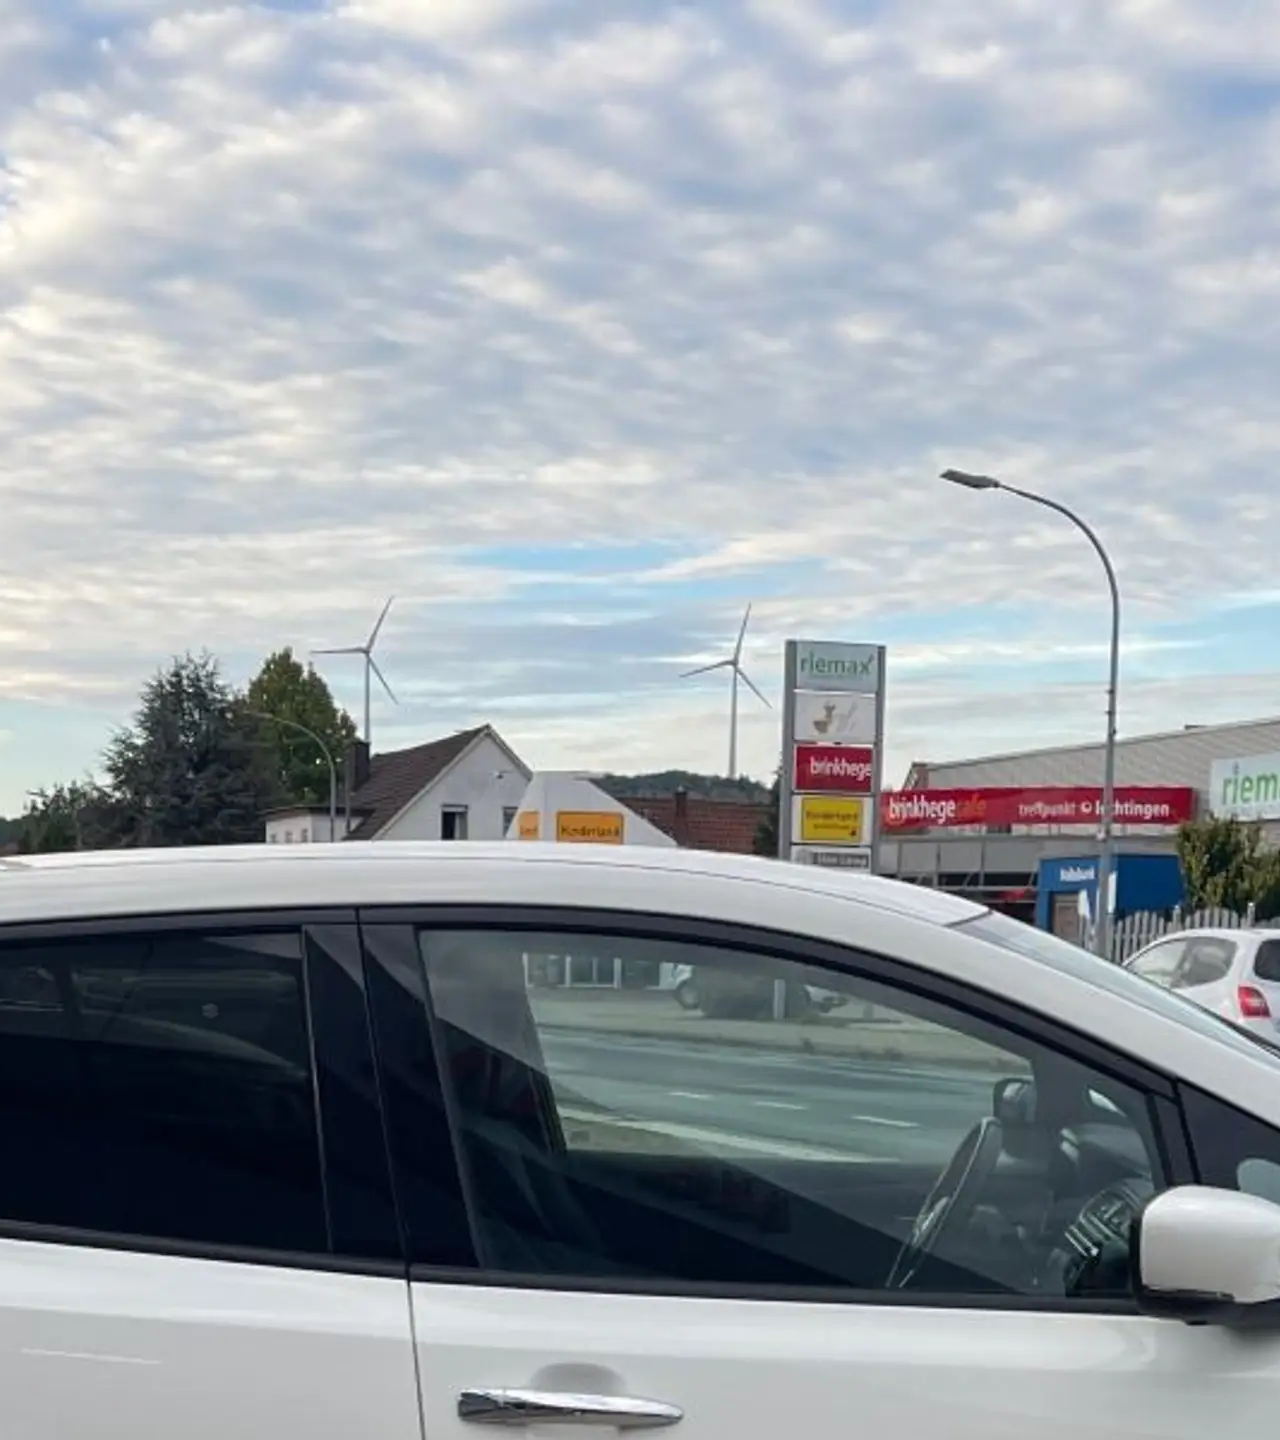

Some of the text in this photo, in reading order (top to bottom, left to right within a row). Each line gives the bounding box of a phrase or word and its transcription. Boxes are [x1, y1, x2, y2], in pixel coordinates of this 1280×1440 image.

[800, 650, 875, 675] riemax
[809, 756, 872, 782] brinkhege
[888, 795, 956, 824] brinkhege
[1095, 799, 1170, 821] lehtingen
